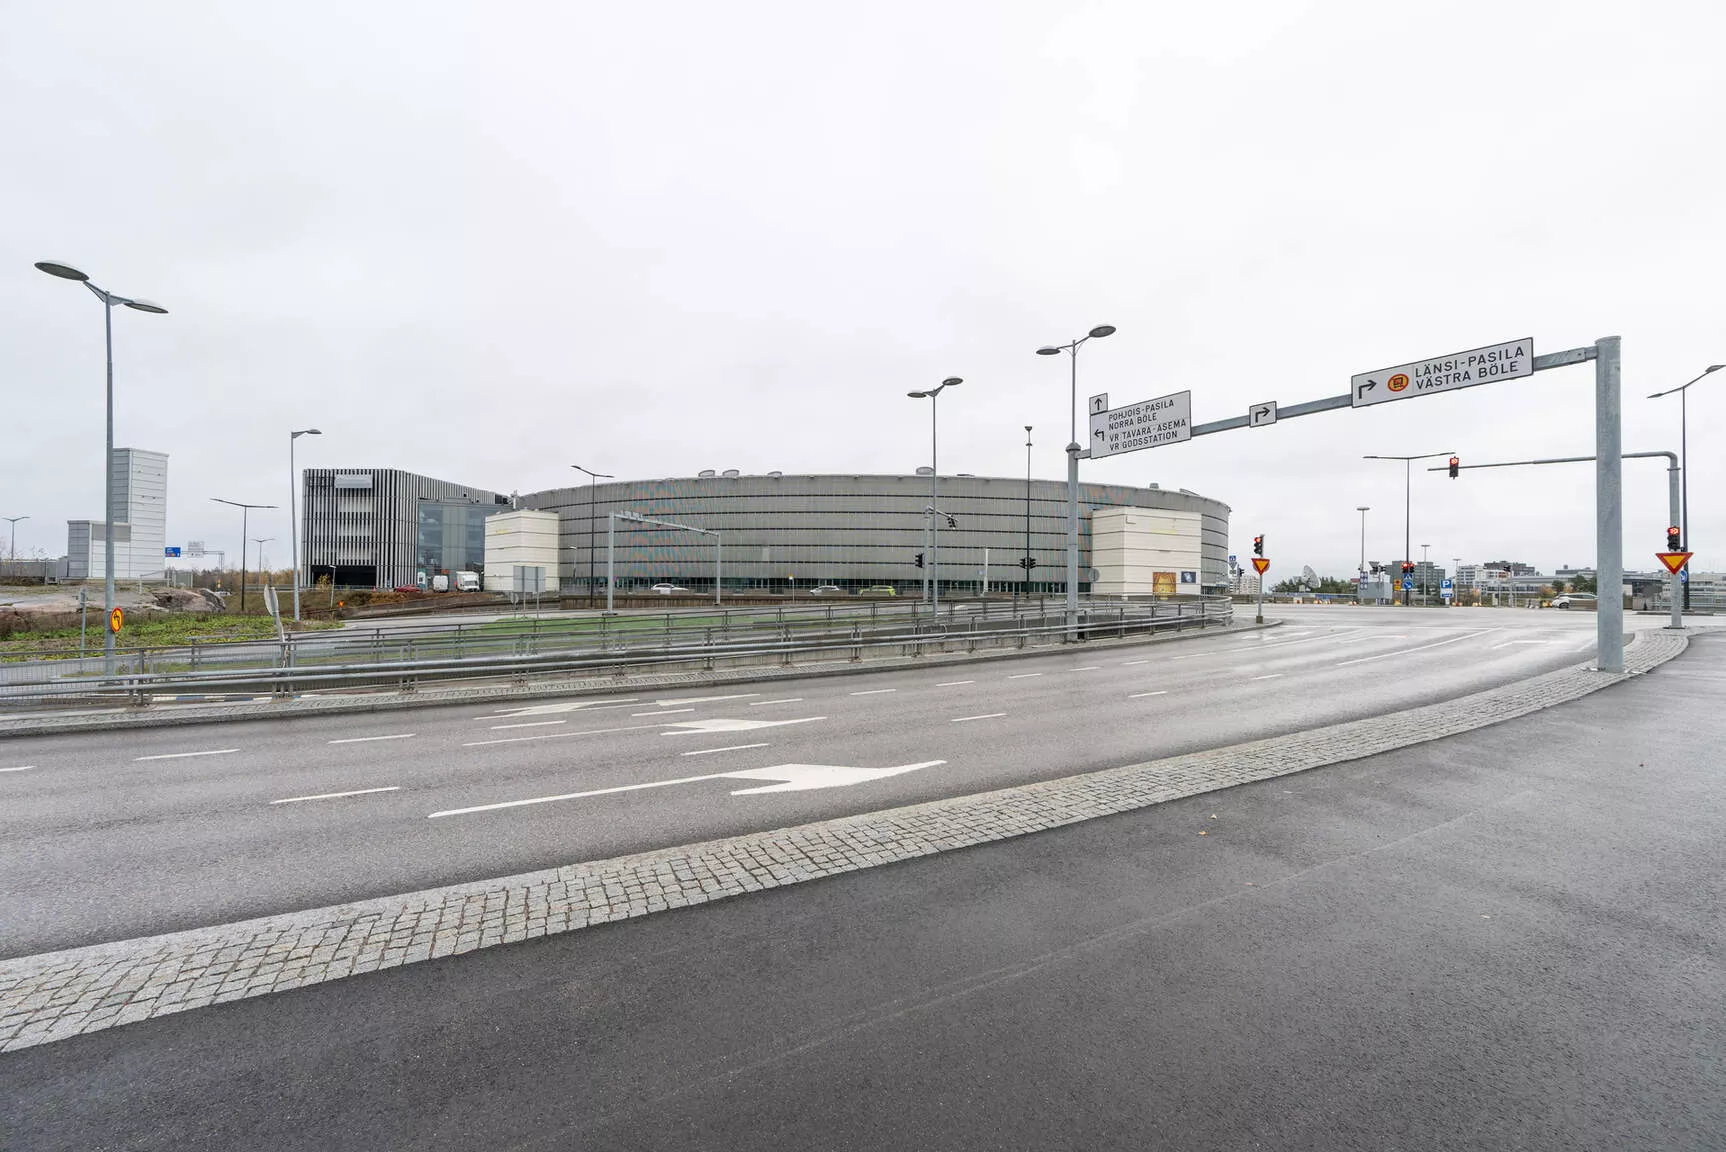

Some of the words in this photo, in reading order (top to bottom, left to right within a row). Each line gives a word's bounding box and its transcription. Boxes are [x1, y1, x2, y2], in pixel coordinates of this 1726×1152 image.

[1415, 346, 1524, 378] LÄNSI-PASILA
[1416, 370, 1471, 390] VÄSTRA
[1478, 361, 1519, 378] BÖLE
[1108, 399, 1174, 422] POHJOIS-PASILA
[1109, 418, 1134, 431] NORRA
[1109, 433, 1119, 442] VR
[1122, 419, 1186, 439] TAVARA-ASEMA
[1109, 442, 1119, 451] VR
[1122, 431, 1178, 449] GODSSTATION
